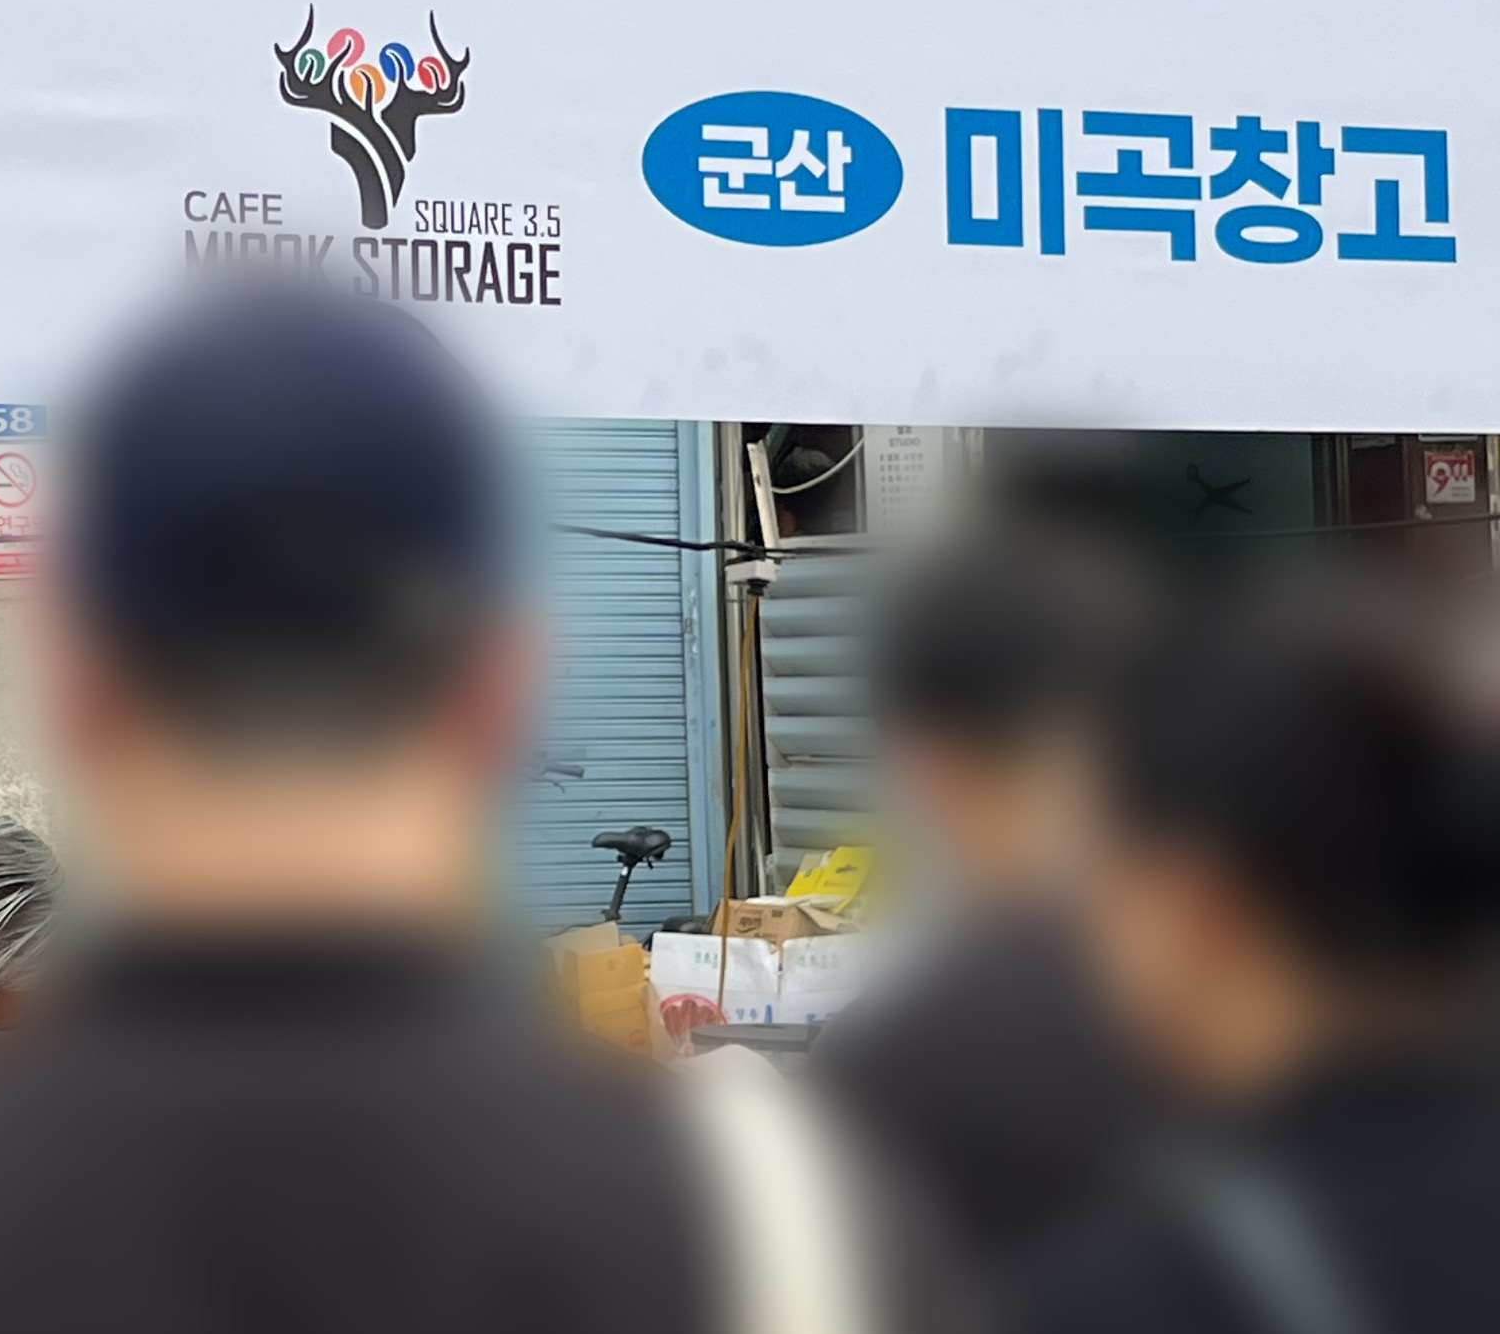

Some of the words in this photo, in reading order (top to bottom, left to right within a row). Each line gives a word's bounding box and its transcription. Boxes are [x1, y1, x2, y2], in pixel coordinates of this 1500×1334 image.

[698, 124, 852, 213] 군산
[944, 106, 1458, 264] 미곡창고
[184, 191, 283, 225] CAFE
[415, 200, 513, 237] SQUARE
[523, 205, 561, 238] 3.5
[352, 237, 562, 306] STORAGE
